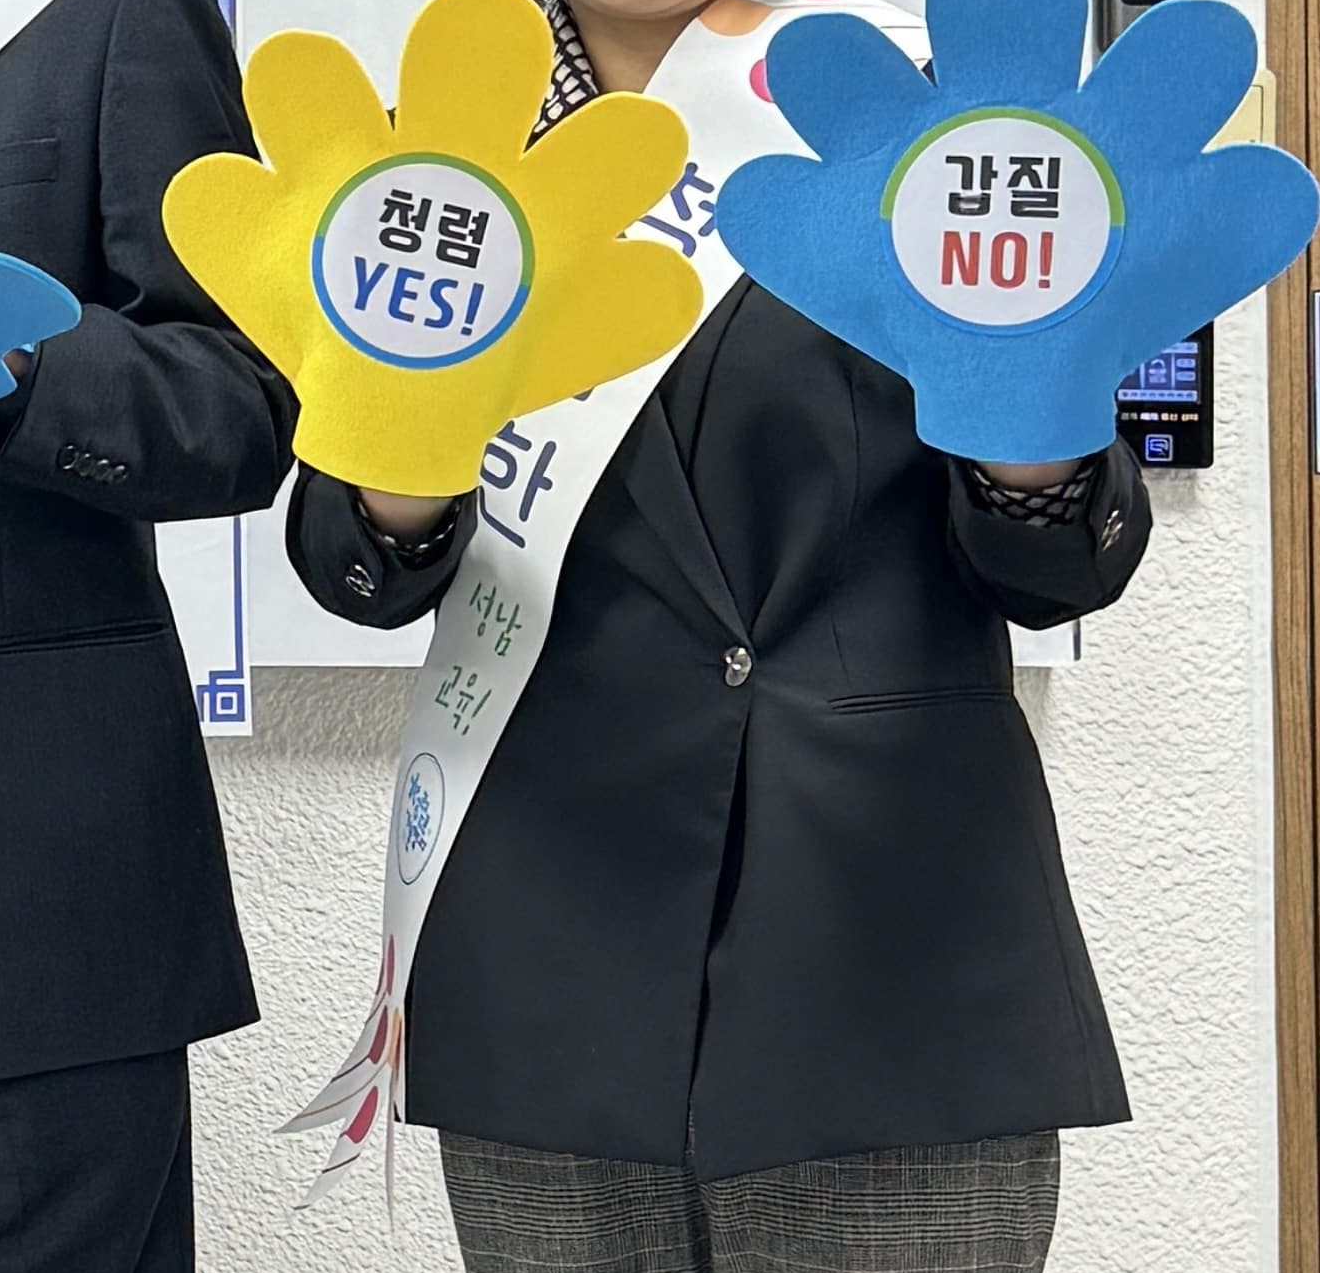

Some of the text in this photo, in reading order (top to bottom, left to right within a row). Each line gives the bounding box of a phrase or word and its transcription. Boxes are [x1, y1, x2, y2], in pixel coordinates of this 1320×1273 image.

[944, 154, 1062, 219] 갑질
[378, 188, 490, 269] 청렴
[941, 230, 1054, 289] NO!
[353, 255, 485, 337] YES!
[468, 581, 522, 657] 성남
[434, 664, 492, 736] 교육!
